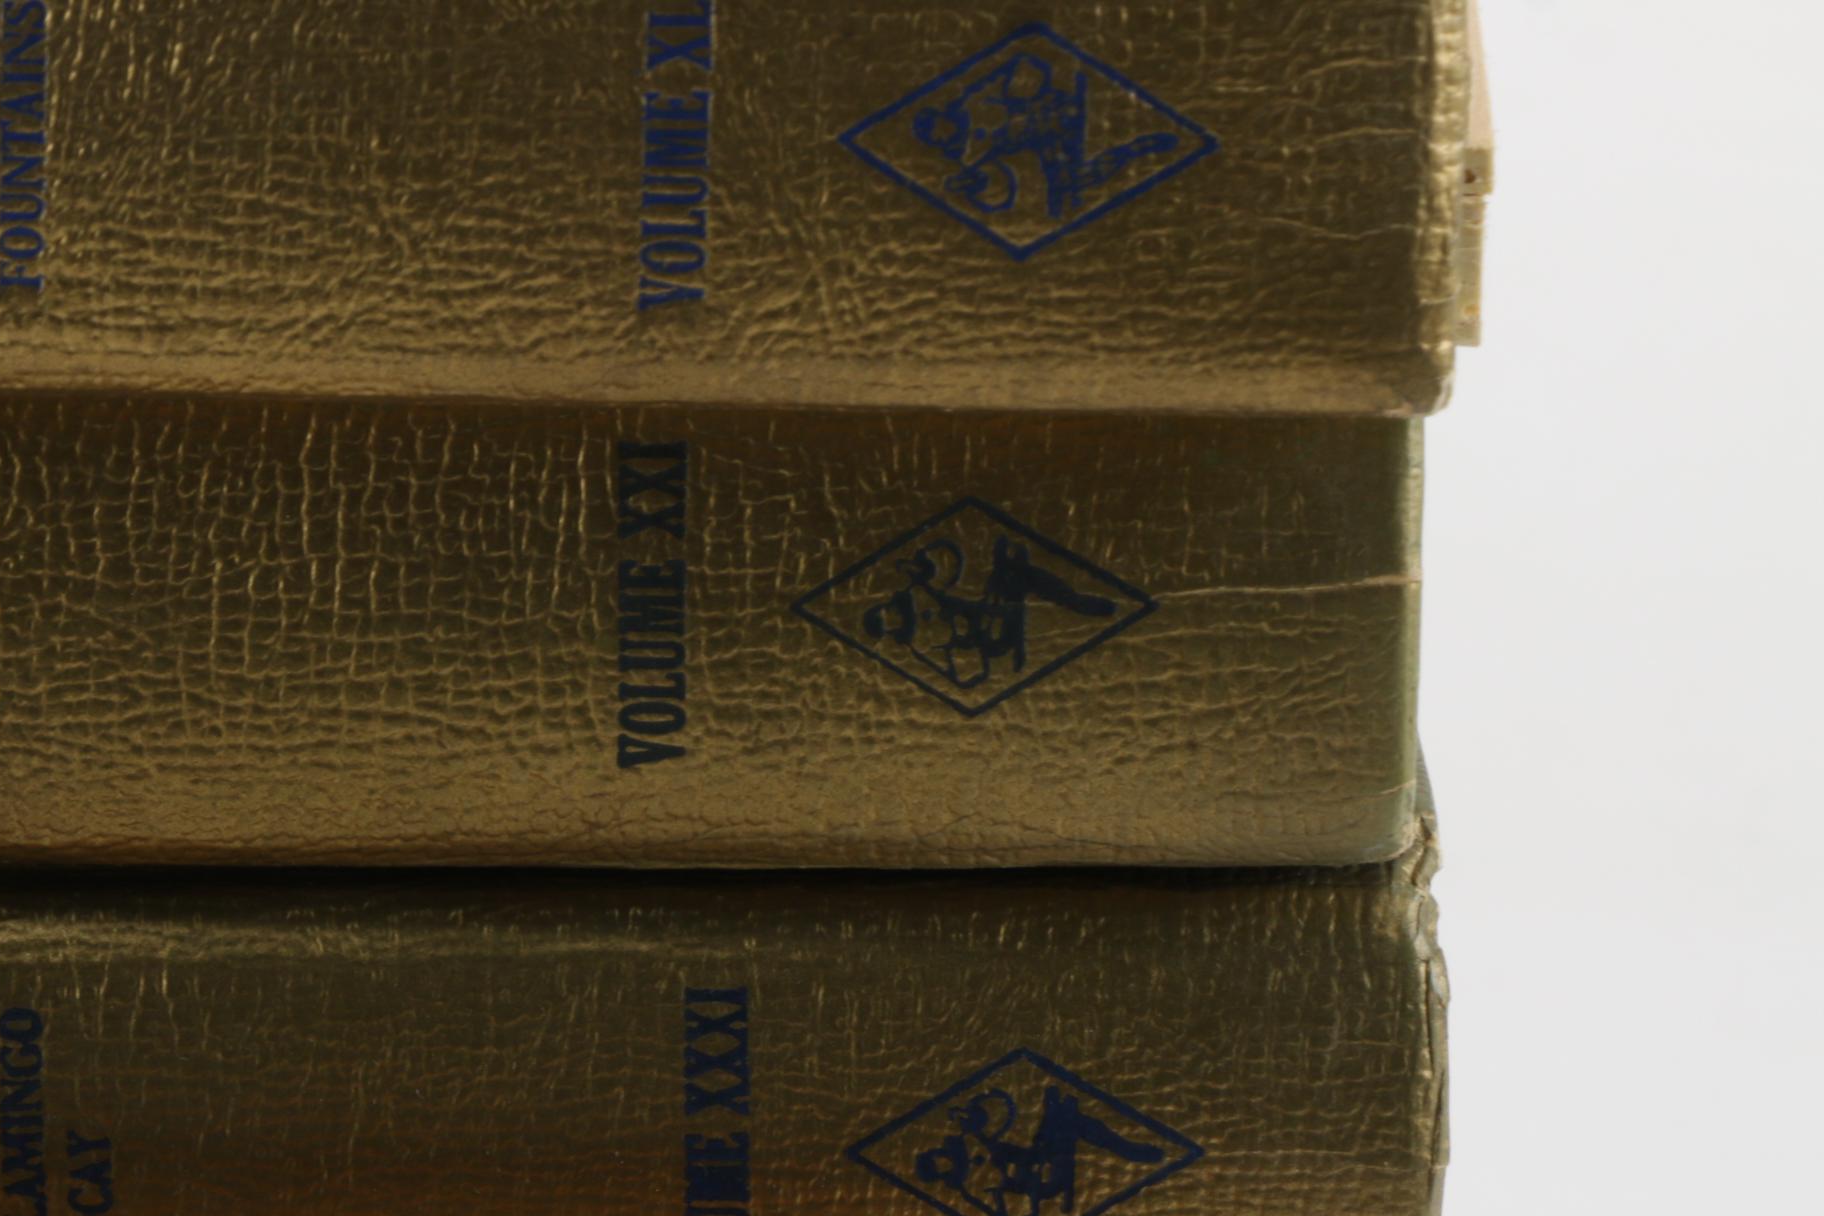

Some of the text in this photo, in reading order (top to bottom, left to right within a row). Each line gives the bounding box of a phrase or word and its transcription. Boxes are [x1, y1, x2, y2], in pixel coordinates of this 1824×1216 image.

[639, 91, 711, 310] VOLUME
[617, 441, 687, 768] VOLUME XXI
[684, 986, 750, 1115] XXXI
[66, 1130, 115, 1216] CAY
